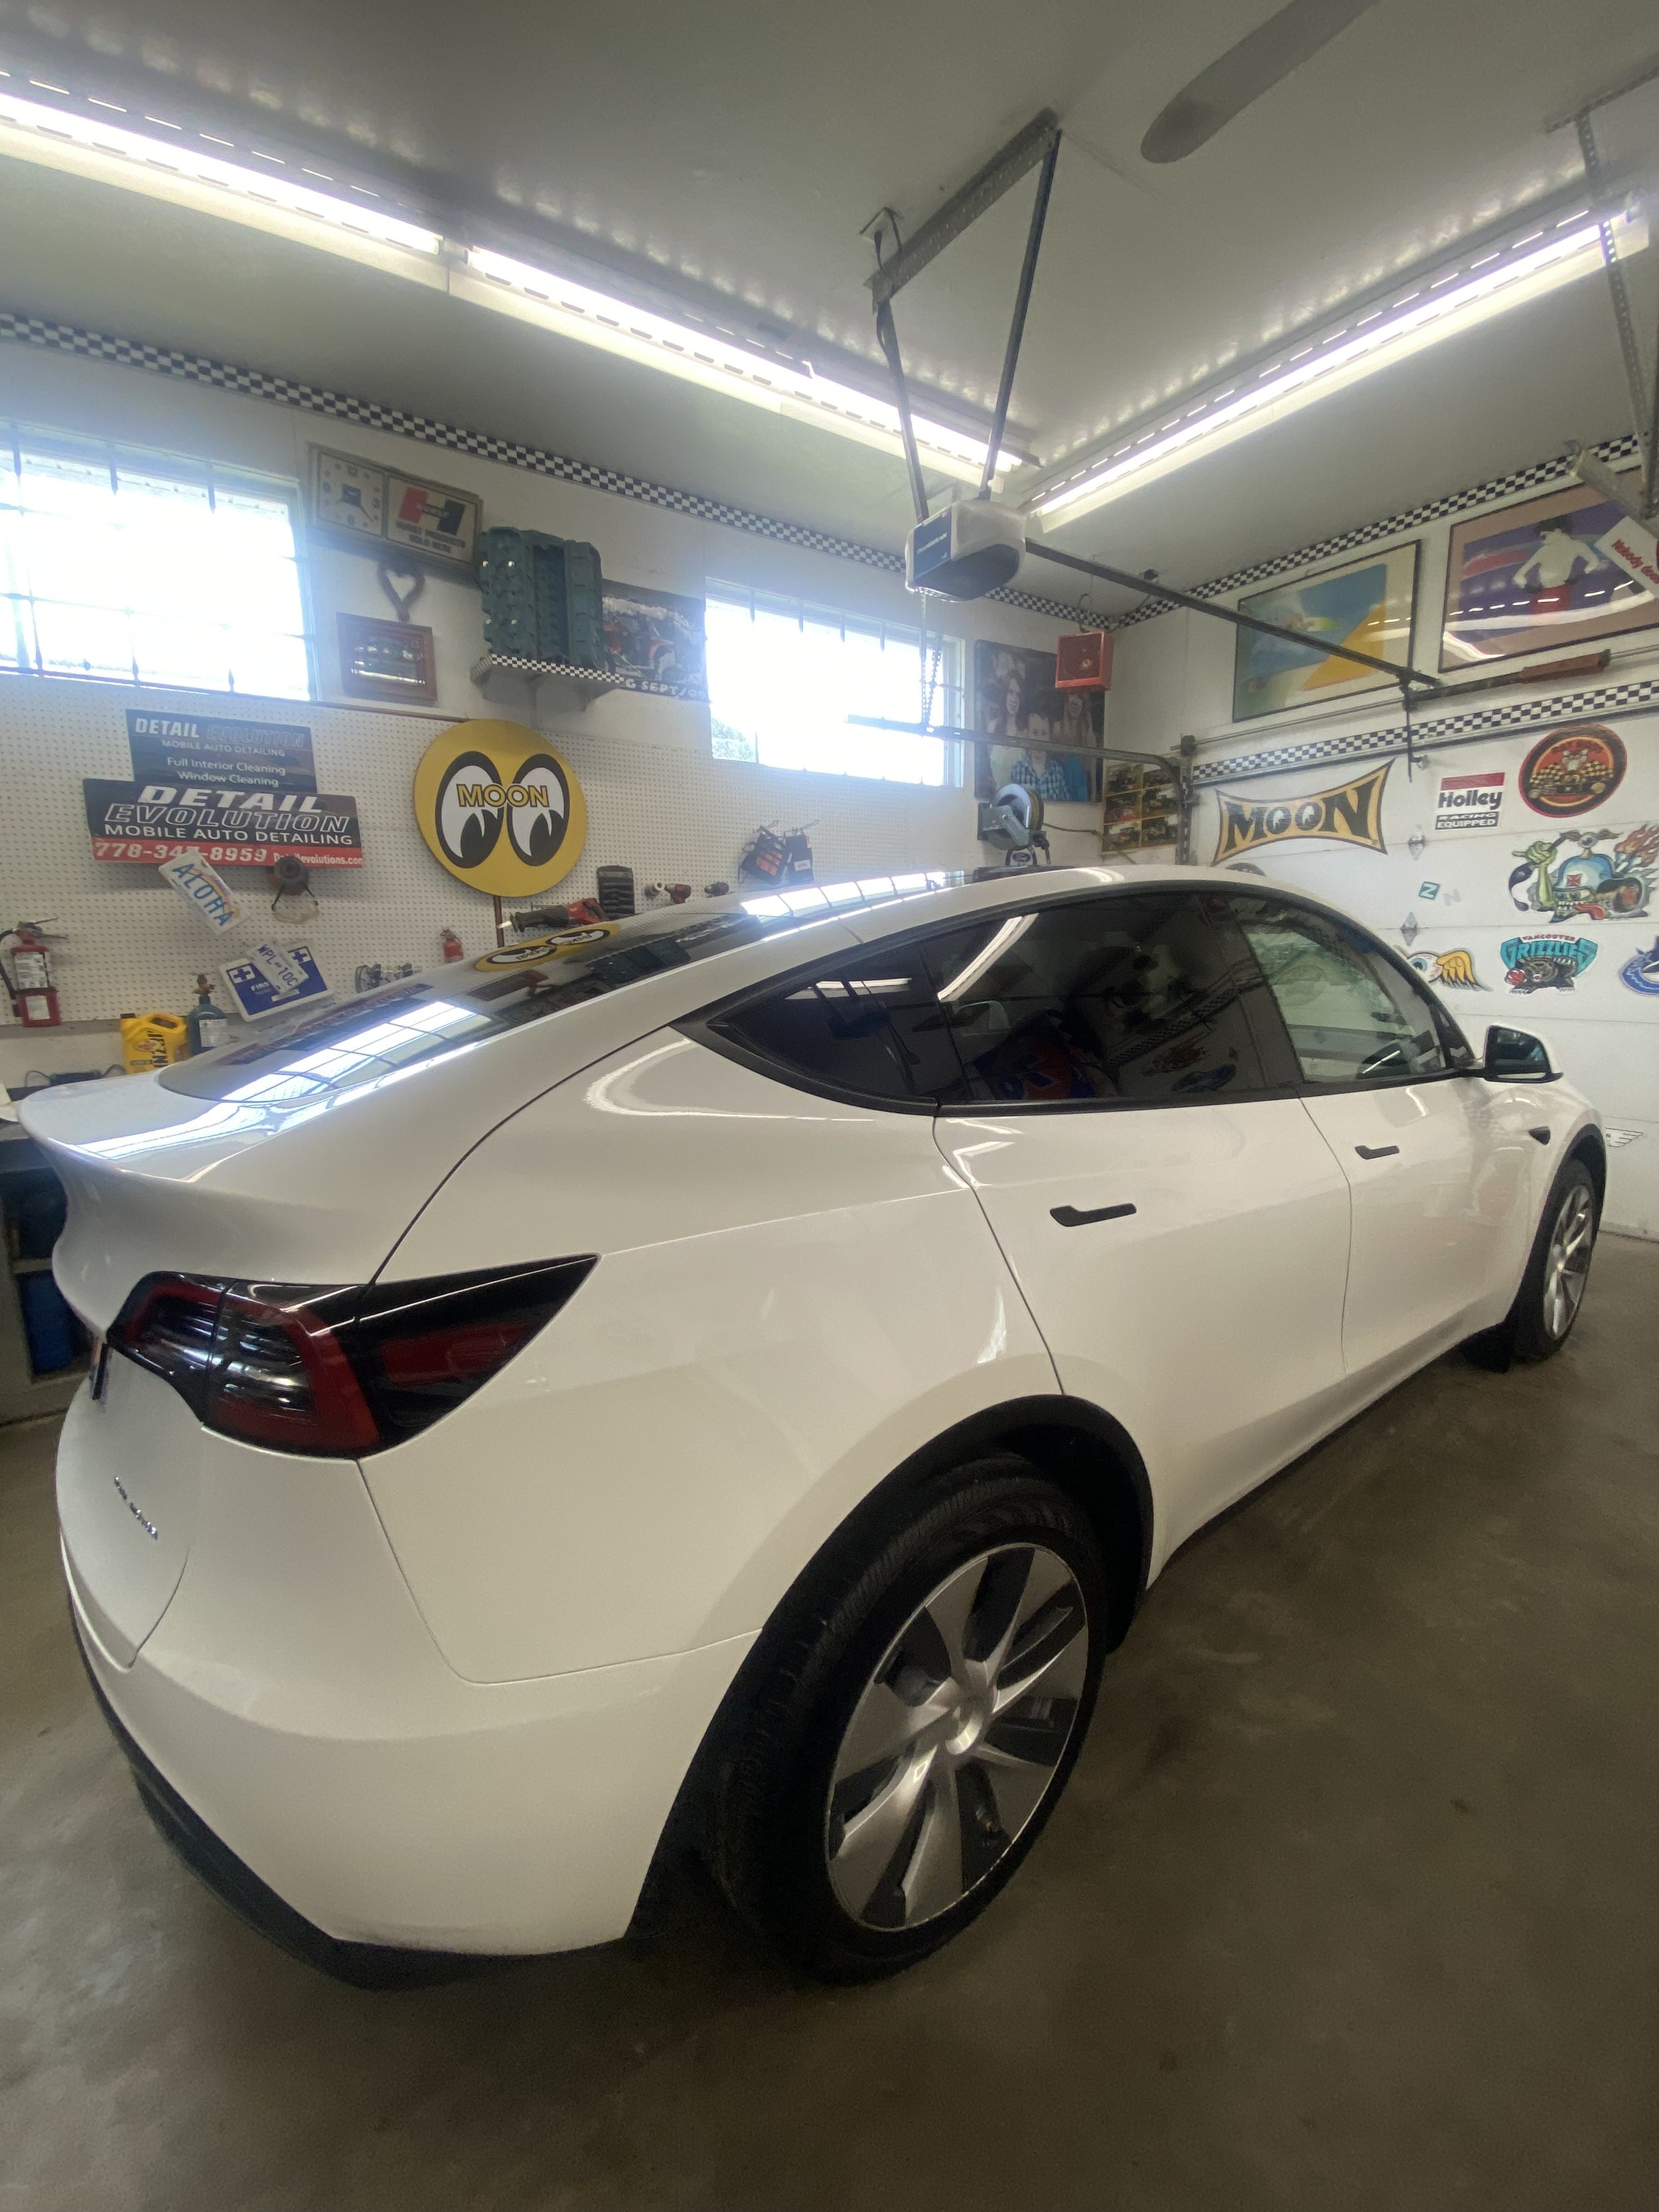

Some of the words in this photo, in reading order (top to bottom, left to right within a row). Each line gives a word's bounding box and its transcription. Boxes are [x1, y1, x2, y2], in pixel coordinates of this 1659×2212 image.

[135, 718, 199, 738] DETAIL
[206, 724, 305, 749] EVOLUTION
[162, 740, 200, 750] MOBILE
[204, 743, 232, 753] AUTO
[235, 746, 285, 757] DETAILING
[167, 757, 188, 767] Full
[192, 759, 234, 770] Interior
[236, 763, 286, 776] Cleaning
[178, 771, 226, 782] Window
[229, 775, 279, 788] Cleaning
[137, 785, 323, 813] DETAIL
[455, 783, 549, 808] MOON
[1438, 790, 1502, 810] Holley
[104, 803, 350, 833] EVOLUTION
[1222, 776, 1381, 853] MOON
[1437, 819, 1496, 828] EQUIPPED
[104, 824, 186, 838] MOBILE
[193, 829, 248, 841] AUTO
[255, 832, 352, 846] DETAILING
[172, 863, 234, 926] ALOHA
[1500, 937, 1598, 976] GRIZZLIES
[251, 982, 270, 992] FIRS
